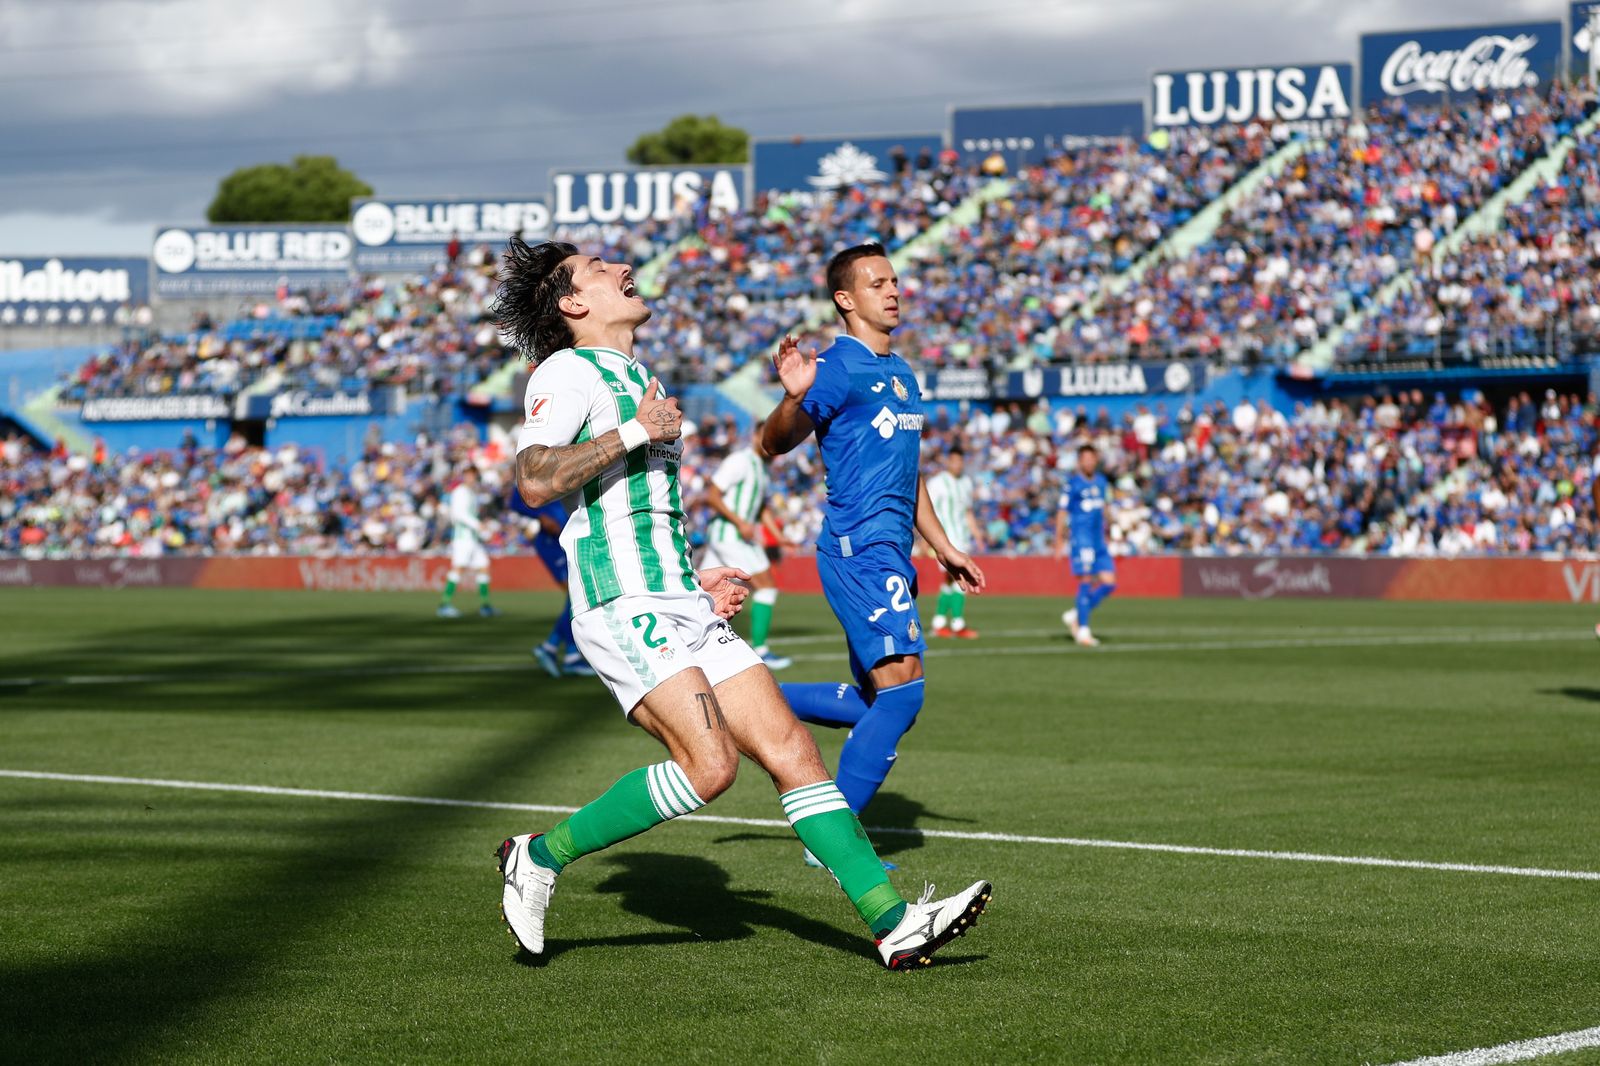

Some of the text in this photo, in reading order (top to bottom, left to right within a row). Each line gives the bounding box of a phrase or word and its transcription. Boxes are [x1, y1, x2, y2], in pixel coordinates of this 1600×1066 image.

[1153, 65, 1350, 126] LUJISA
[394, 202, 550, 234] BLUE RED
[195, 231, 281, 261] BLUE
[283, 231, 351, 261] RED
[631, 612, 667, 649] 2
